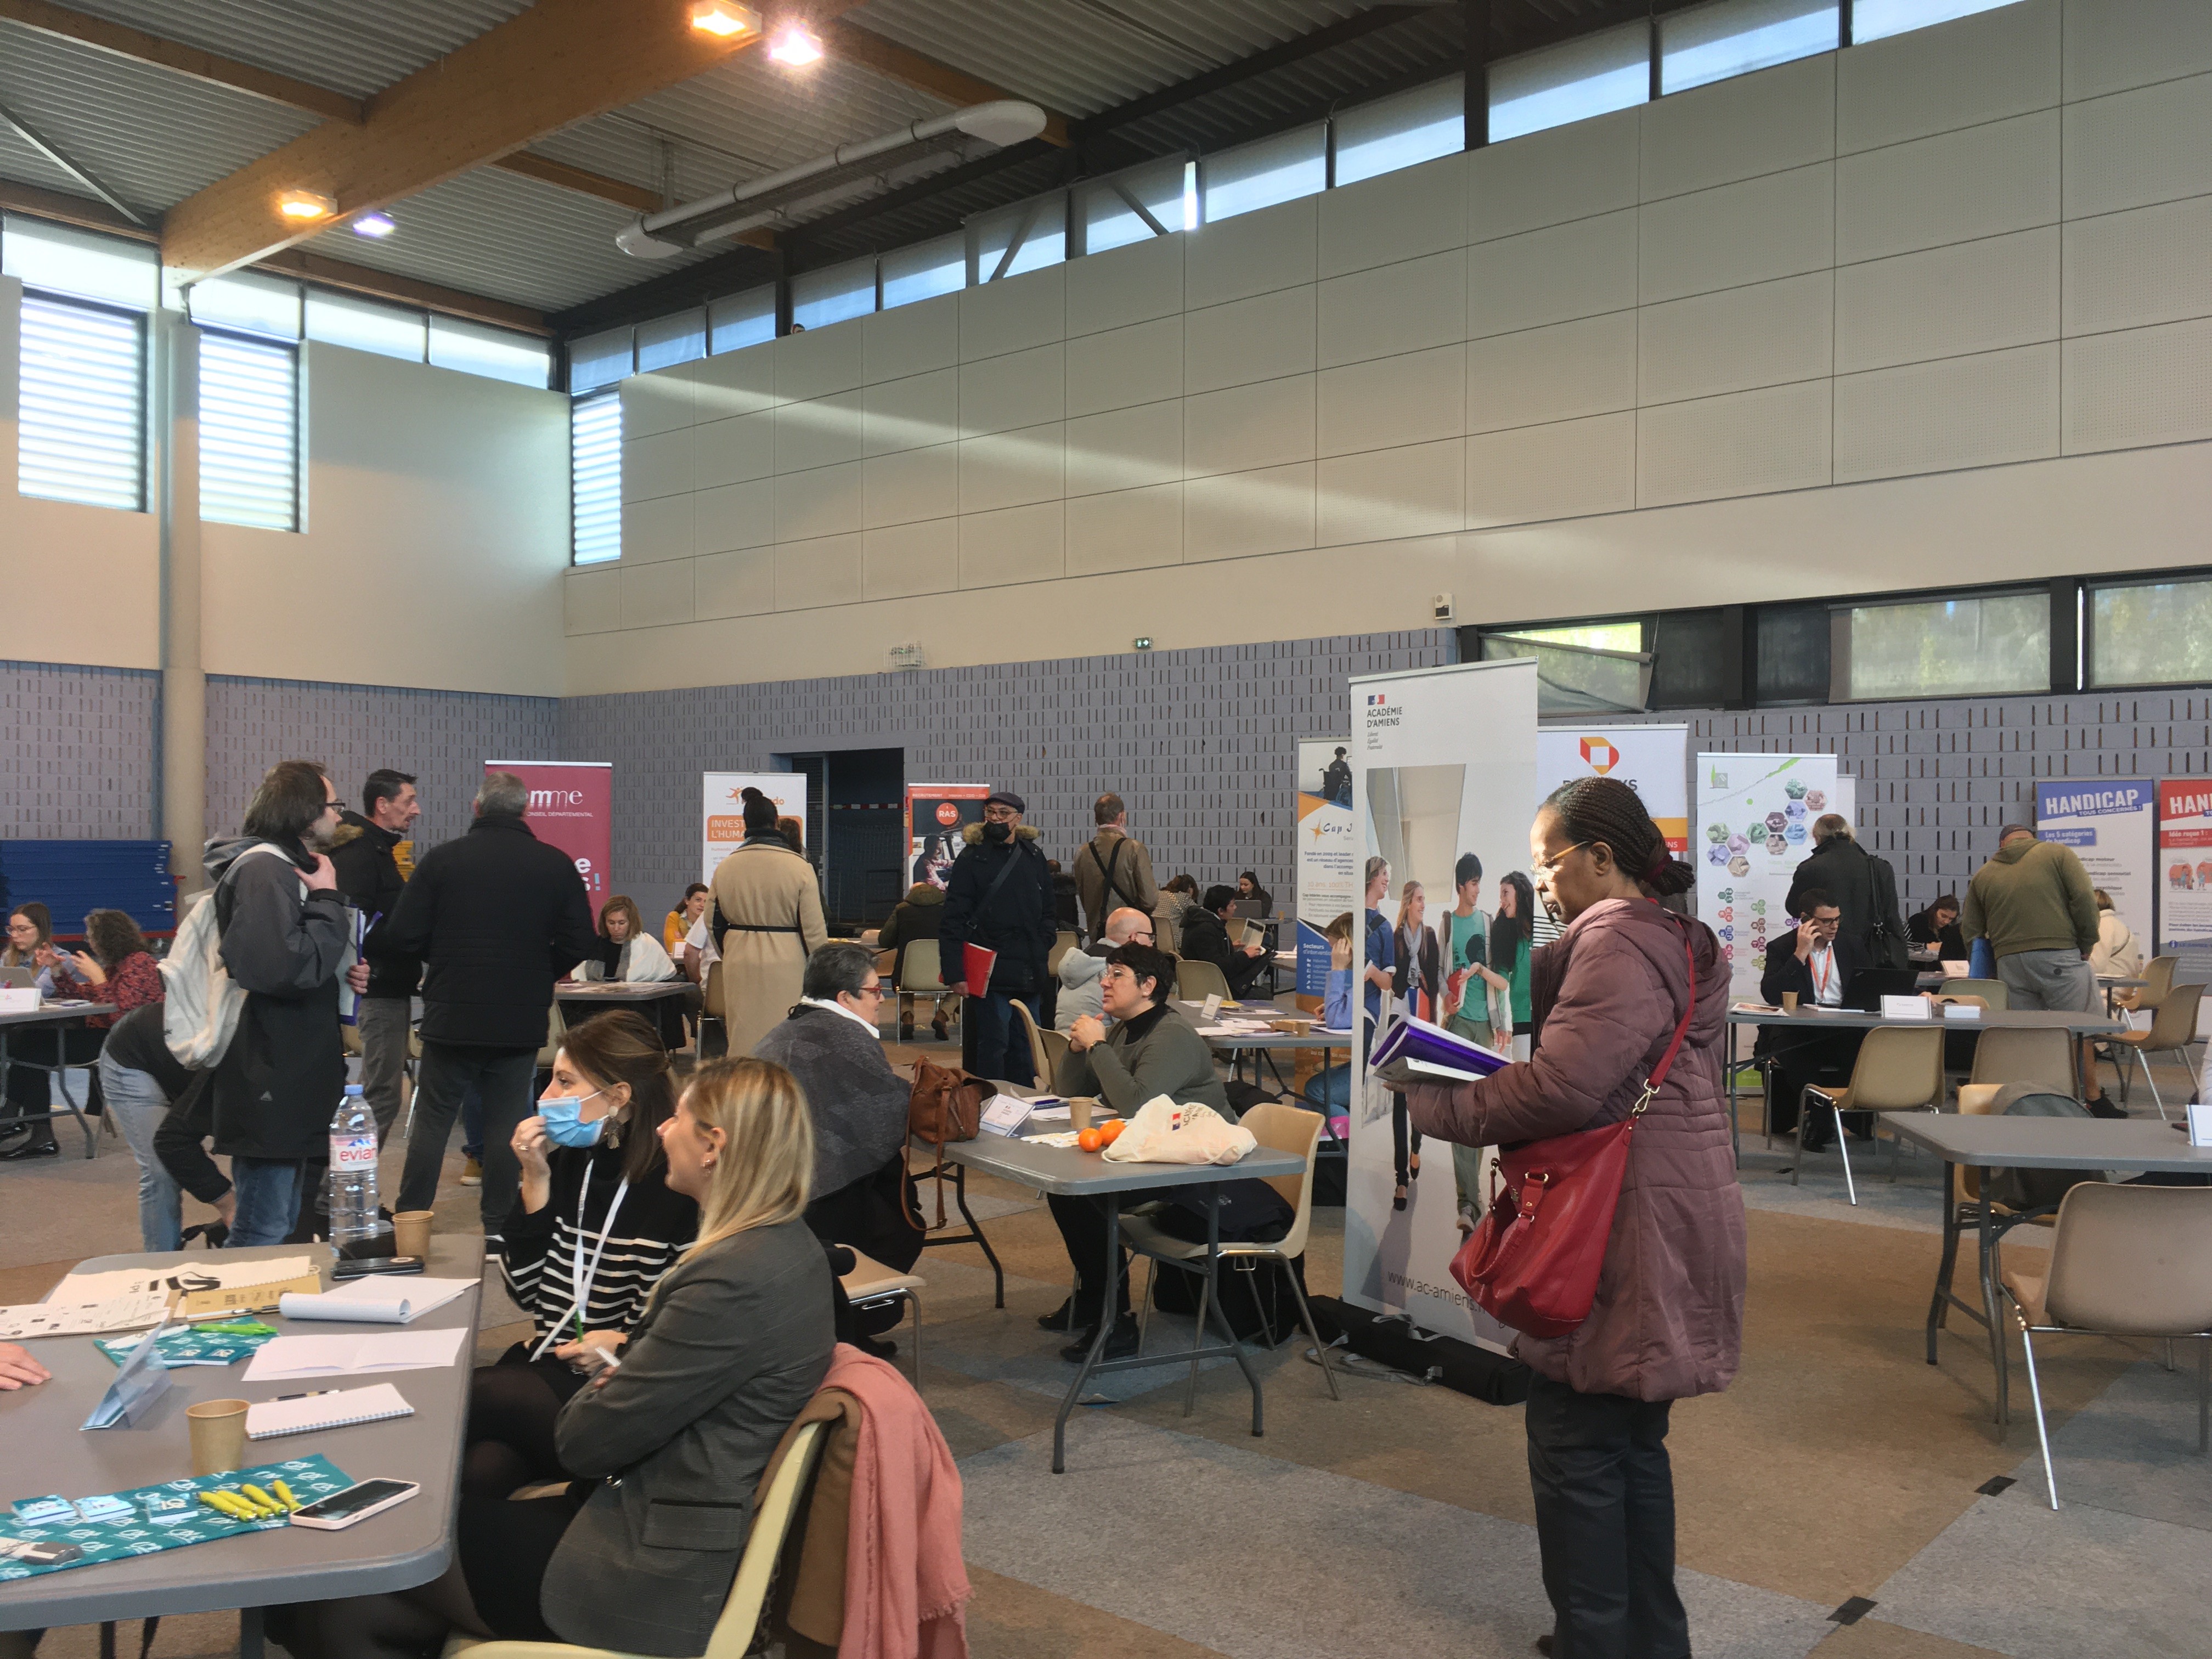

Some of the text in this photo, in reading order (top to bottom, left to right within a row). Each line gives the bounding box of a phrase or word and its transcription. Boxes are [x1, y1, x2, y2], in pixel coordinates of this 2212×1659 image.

[1367, 706, 1403, 718] ACADÉMIE
[1367, 717, 1400, 728] D'AMIENS
[527, 789, 583, 805] mme
[2045, 788, 2139, 815] HANDICAP
[2097, 805, 2138, 815] CONCERNÉS
[711, 819, 745, 828] INVEST
[1323, 822, 1342, 834] Cap
[711, 830, 745, 839] L'HUMA
[2062, 830, 2093, 838] catégories
